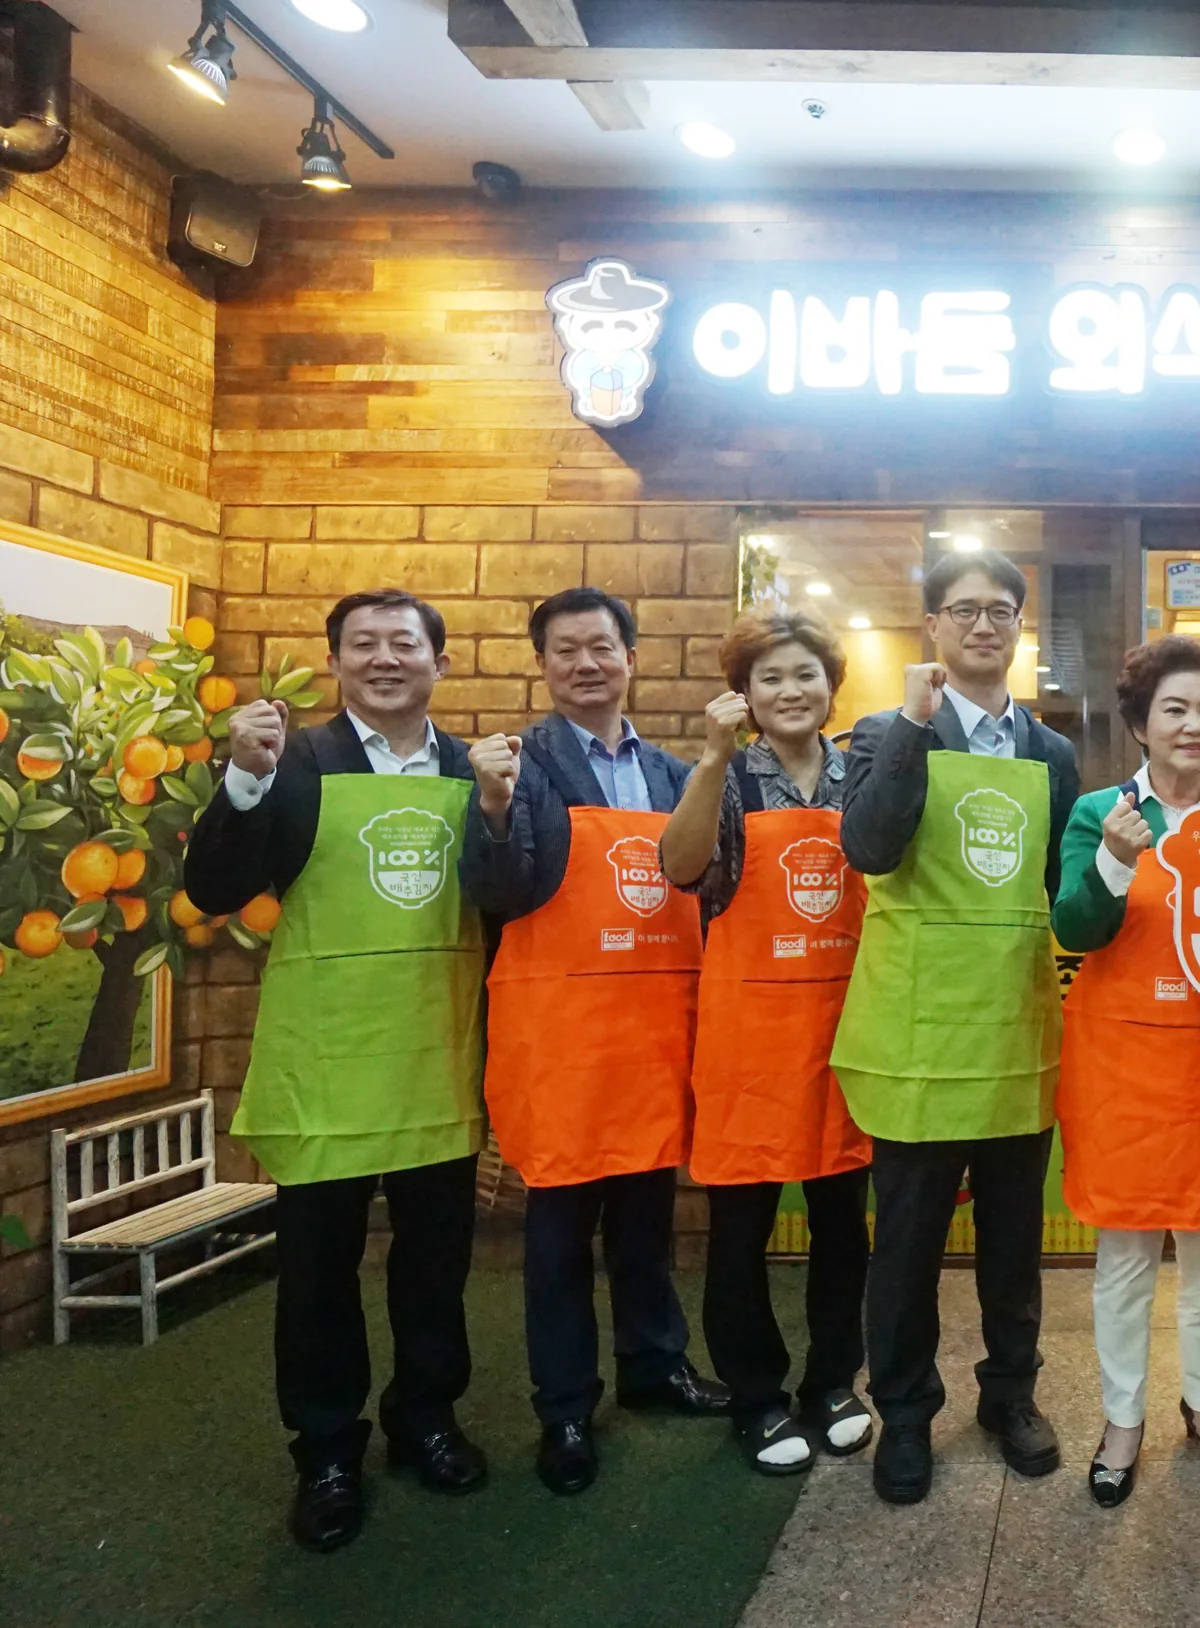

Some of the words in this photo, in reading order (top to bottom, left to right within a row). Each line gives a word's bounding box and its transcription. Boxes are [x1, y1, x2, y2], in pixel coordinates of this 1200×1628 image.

[969, 827, 1016, 847] 100%
[379, 849, 440, 866] 100%
[793, 872, 838, 887] 100%
[390, 884, 432, 897] 배추김치
